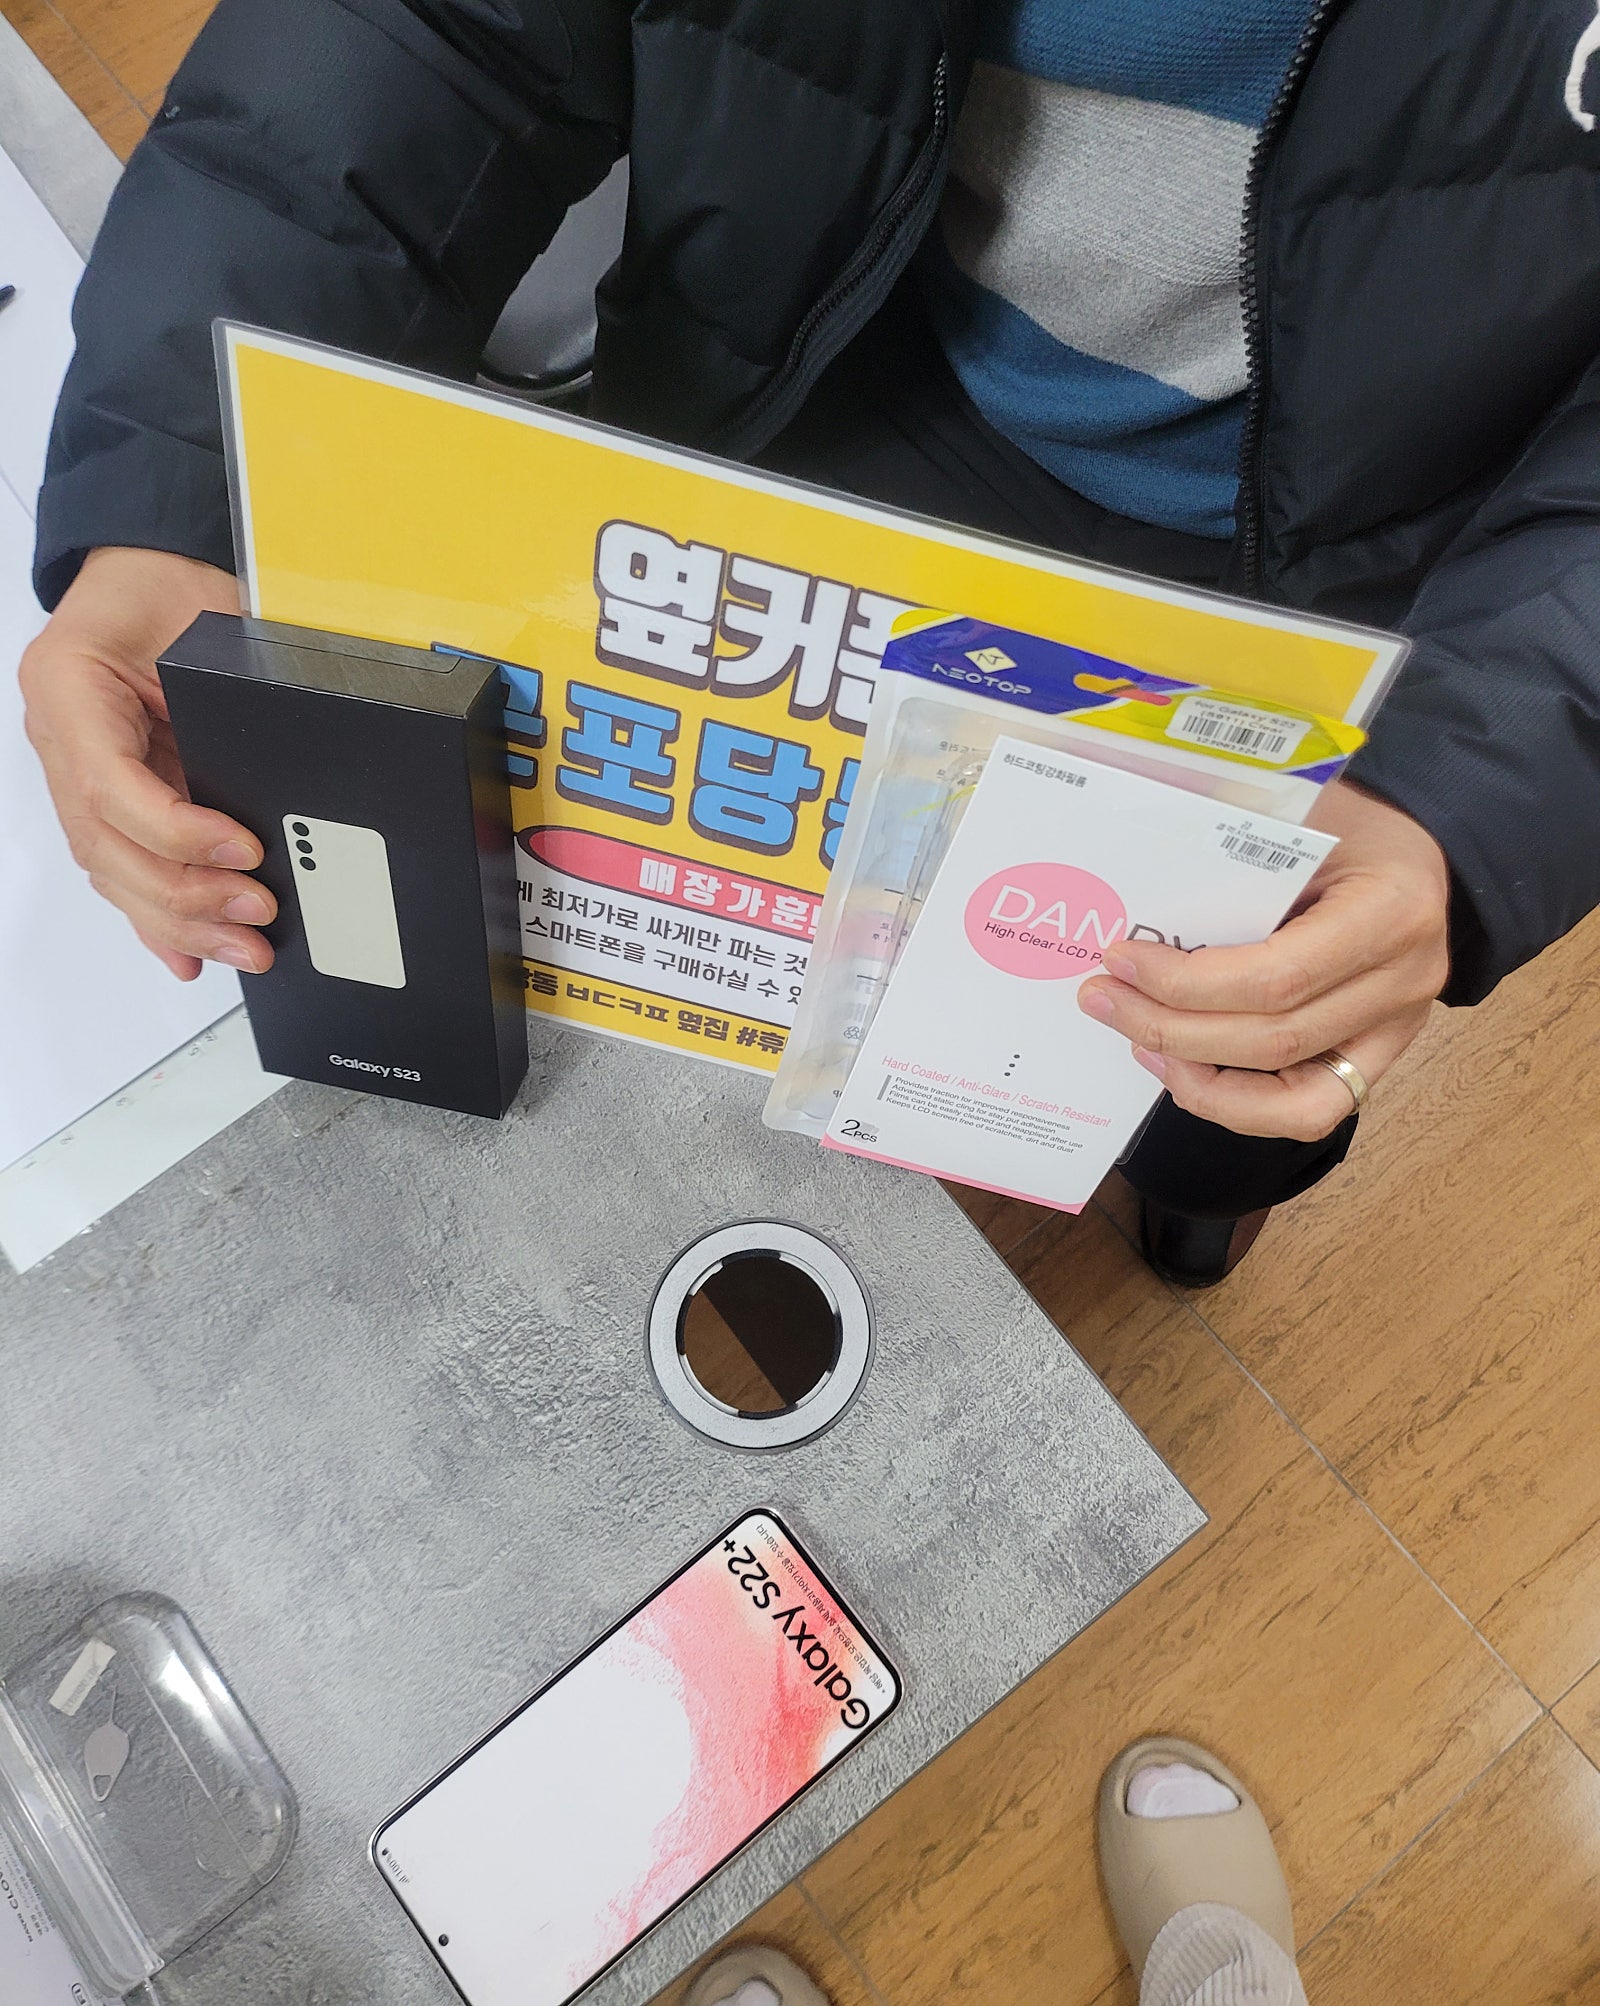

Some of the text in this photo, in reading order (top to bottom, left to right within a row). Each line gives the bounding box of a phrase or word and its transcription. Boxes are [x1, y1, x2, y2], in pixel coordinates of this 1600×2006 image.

[931, 662, 1032, 695] NEOTOP
[1219, 705, 1267, 722] Galaxy
[1271, 717, 1297, 729] S23
[1003, 753, 1087, 788] 하드코팅강화필름
[541, 886, 639, 932] 최저가로
[646, 915, 721, 954] 싸게만
[728, 937, 777, 967] 파는
[984, 921, 1104, 964] High Clear LCD P
[525, 916, 646, 965] 스마트폰을
[653, 949, 750, 992] 구매하실
[756, 974, 781, 999] 수
[677, 1009, 729, 1042] 옆집
[736, 1026, 789, 1056] #휴
[328, 1054, 421, 1082] Galaxy S23
[881, 1055, 911, 1072] Hard
[911, 1064, 951, 1084] Coated
[957, 1078, 1010, 1101] Anti-Glare
[1019, 1094, 1060, 1114] Scratch
[1061, 1106, 1113, 1128] Resistant
[885, 1096, 911, 1110] Keeps
[912, 1104, 931, 1114] LCD
[931, 1110, 958, 1122] screen
[958, 1117, 974, 1127] free
[985, 1126, 1024, 1141] scratches,
[1040, 1140, 1056, 1149] and
[1056, 1144, 1075, 1154] dust
[889, 1090, 910, 1101] Films
[911, 1097, 927, 1106] can
[939, 1105, 962, 1117] easily
[963, 1110, 995, 1125] cleaned
[995, 1119, 1012, 1130] and
[1012, 1125, 1049, 1141] reapplied
[1049, 1135, 1068, 1146] after
[1068, 1140, 1083, 1149] use
[892, 1084, 932, 1100] Advanced
[933, 1096, 955, 1107] static
[956, 1103, 976, 1115] cling
[988, 1111, 1005, 1121] stay
[1020, 1120, 1056, 1134] adhesion
[895, 1076, 929, 1092] Provides
[930, 1087, 960, 1101] traction
[973, 1101, 1011, 1116] improved
[1011, 1110, 1071, 1131] responsiveness
[756, 1523, 779, 1552] 있습니다
[791, 1571, 810, 1593] 차이가
[723, 1538, 871, 1730] Galaxy S22+
